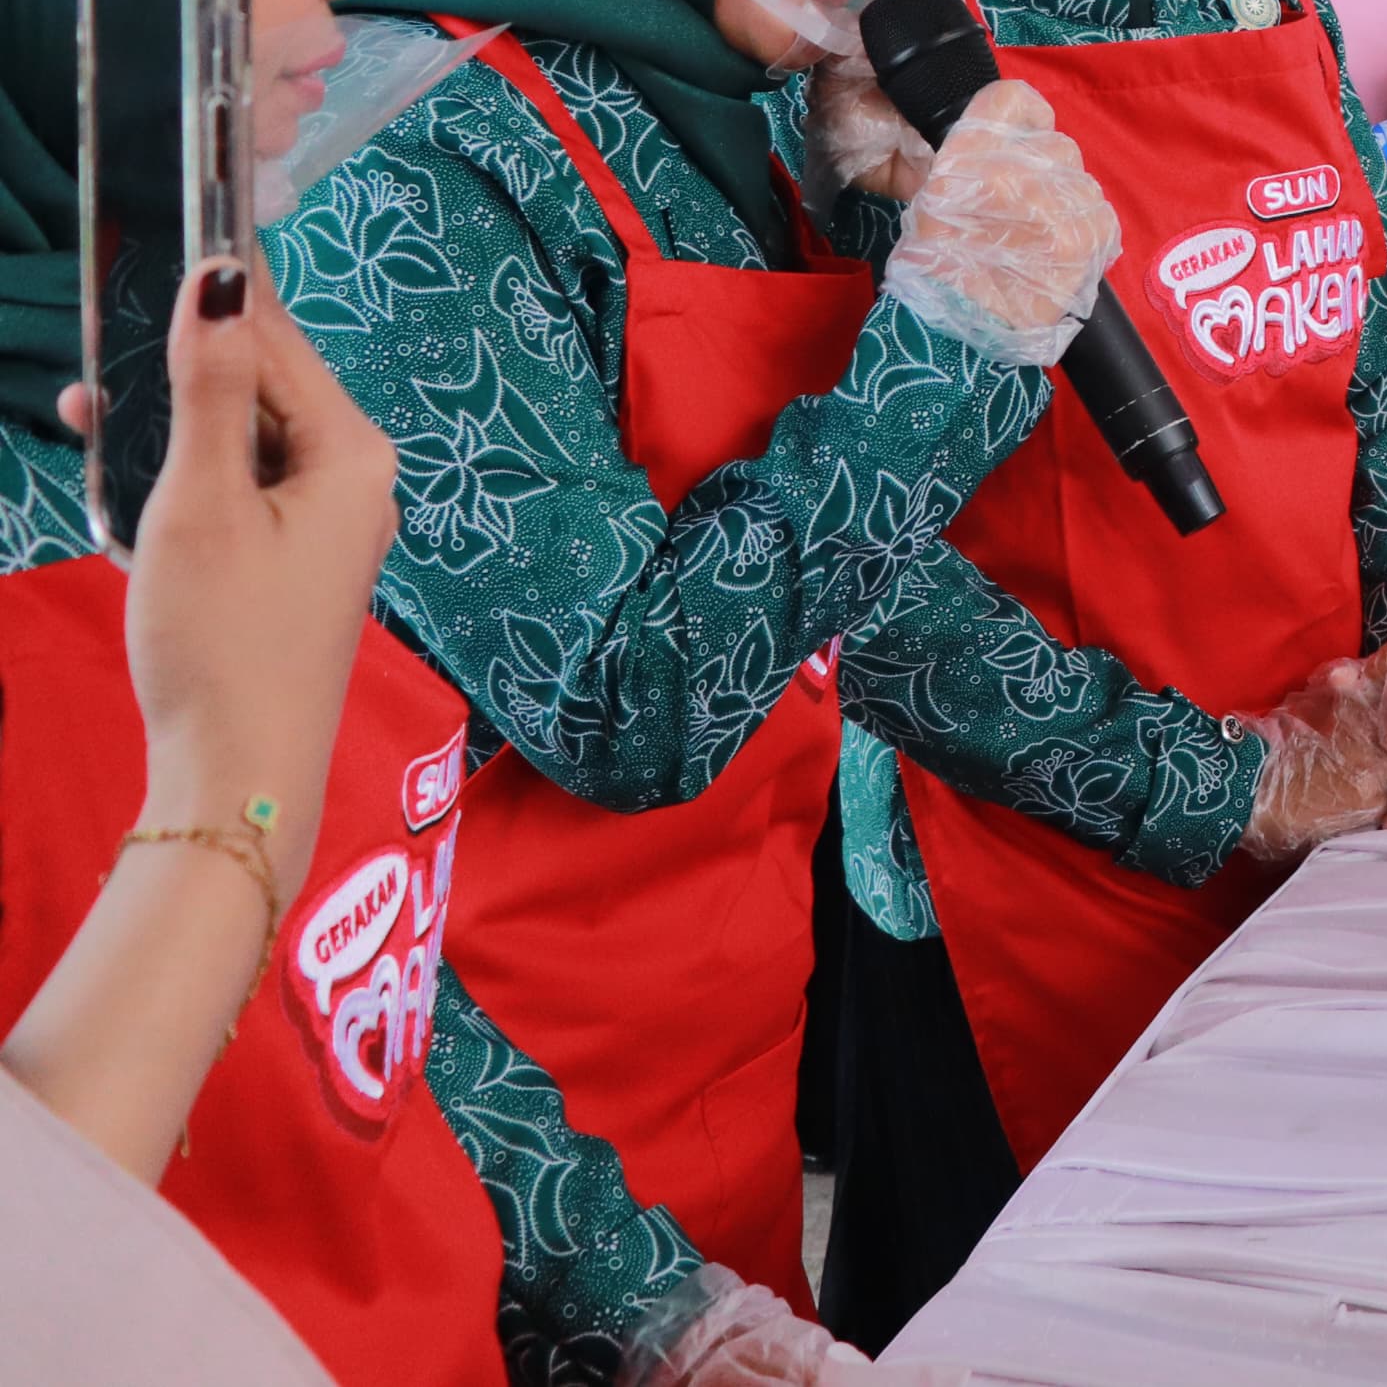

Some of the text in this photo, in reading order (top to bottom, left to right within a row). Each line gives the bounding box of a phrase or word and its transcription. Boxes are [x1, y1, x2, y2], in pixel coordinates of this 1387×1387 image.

[1263, 171, 1328, 211] SUN
[1169, 219, 1364, 282] GERAKAN LAHAP
[1190, 264, 1366, 365] MAKAN
[314, 866, 398, 964] GERAKAN
